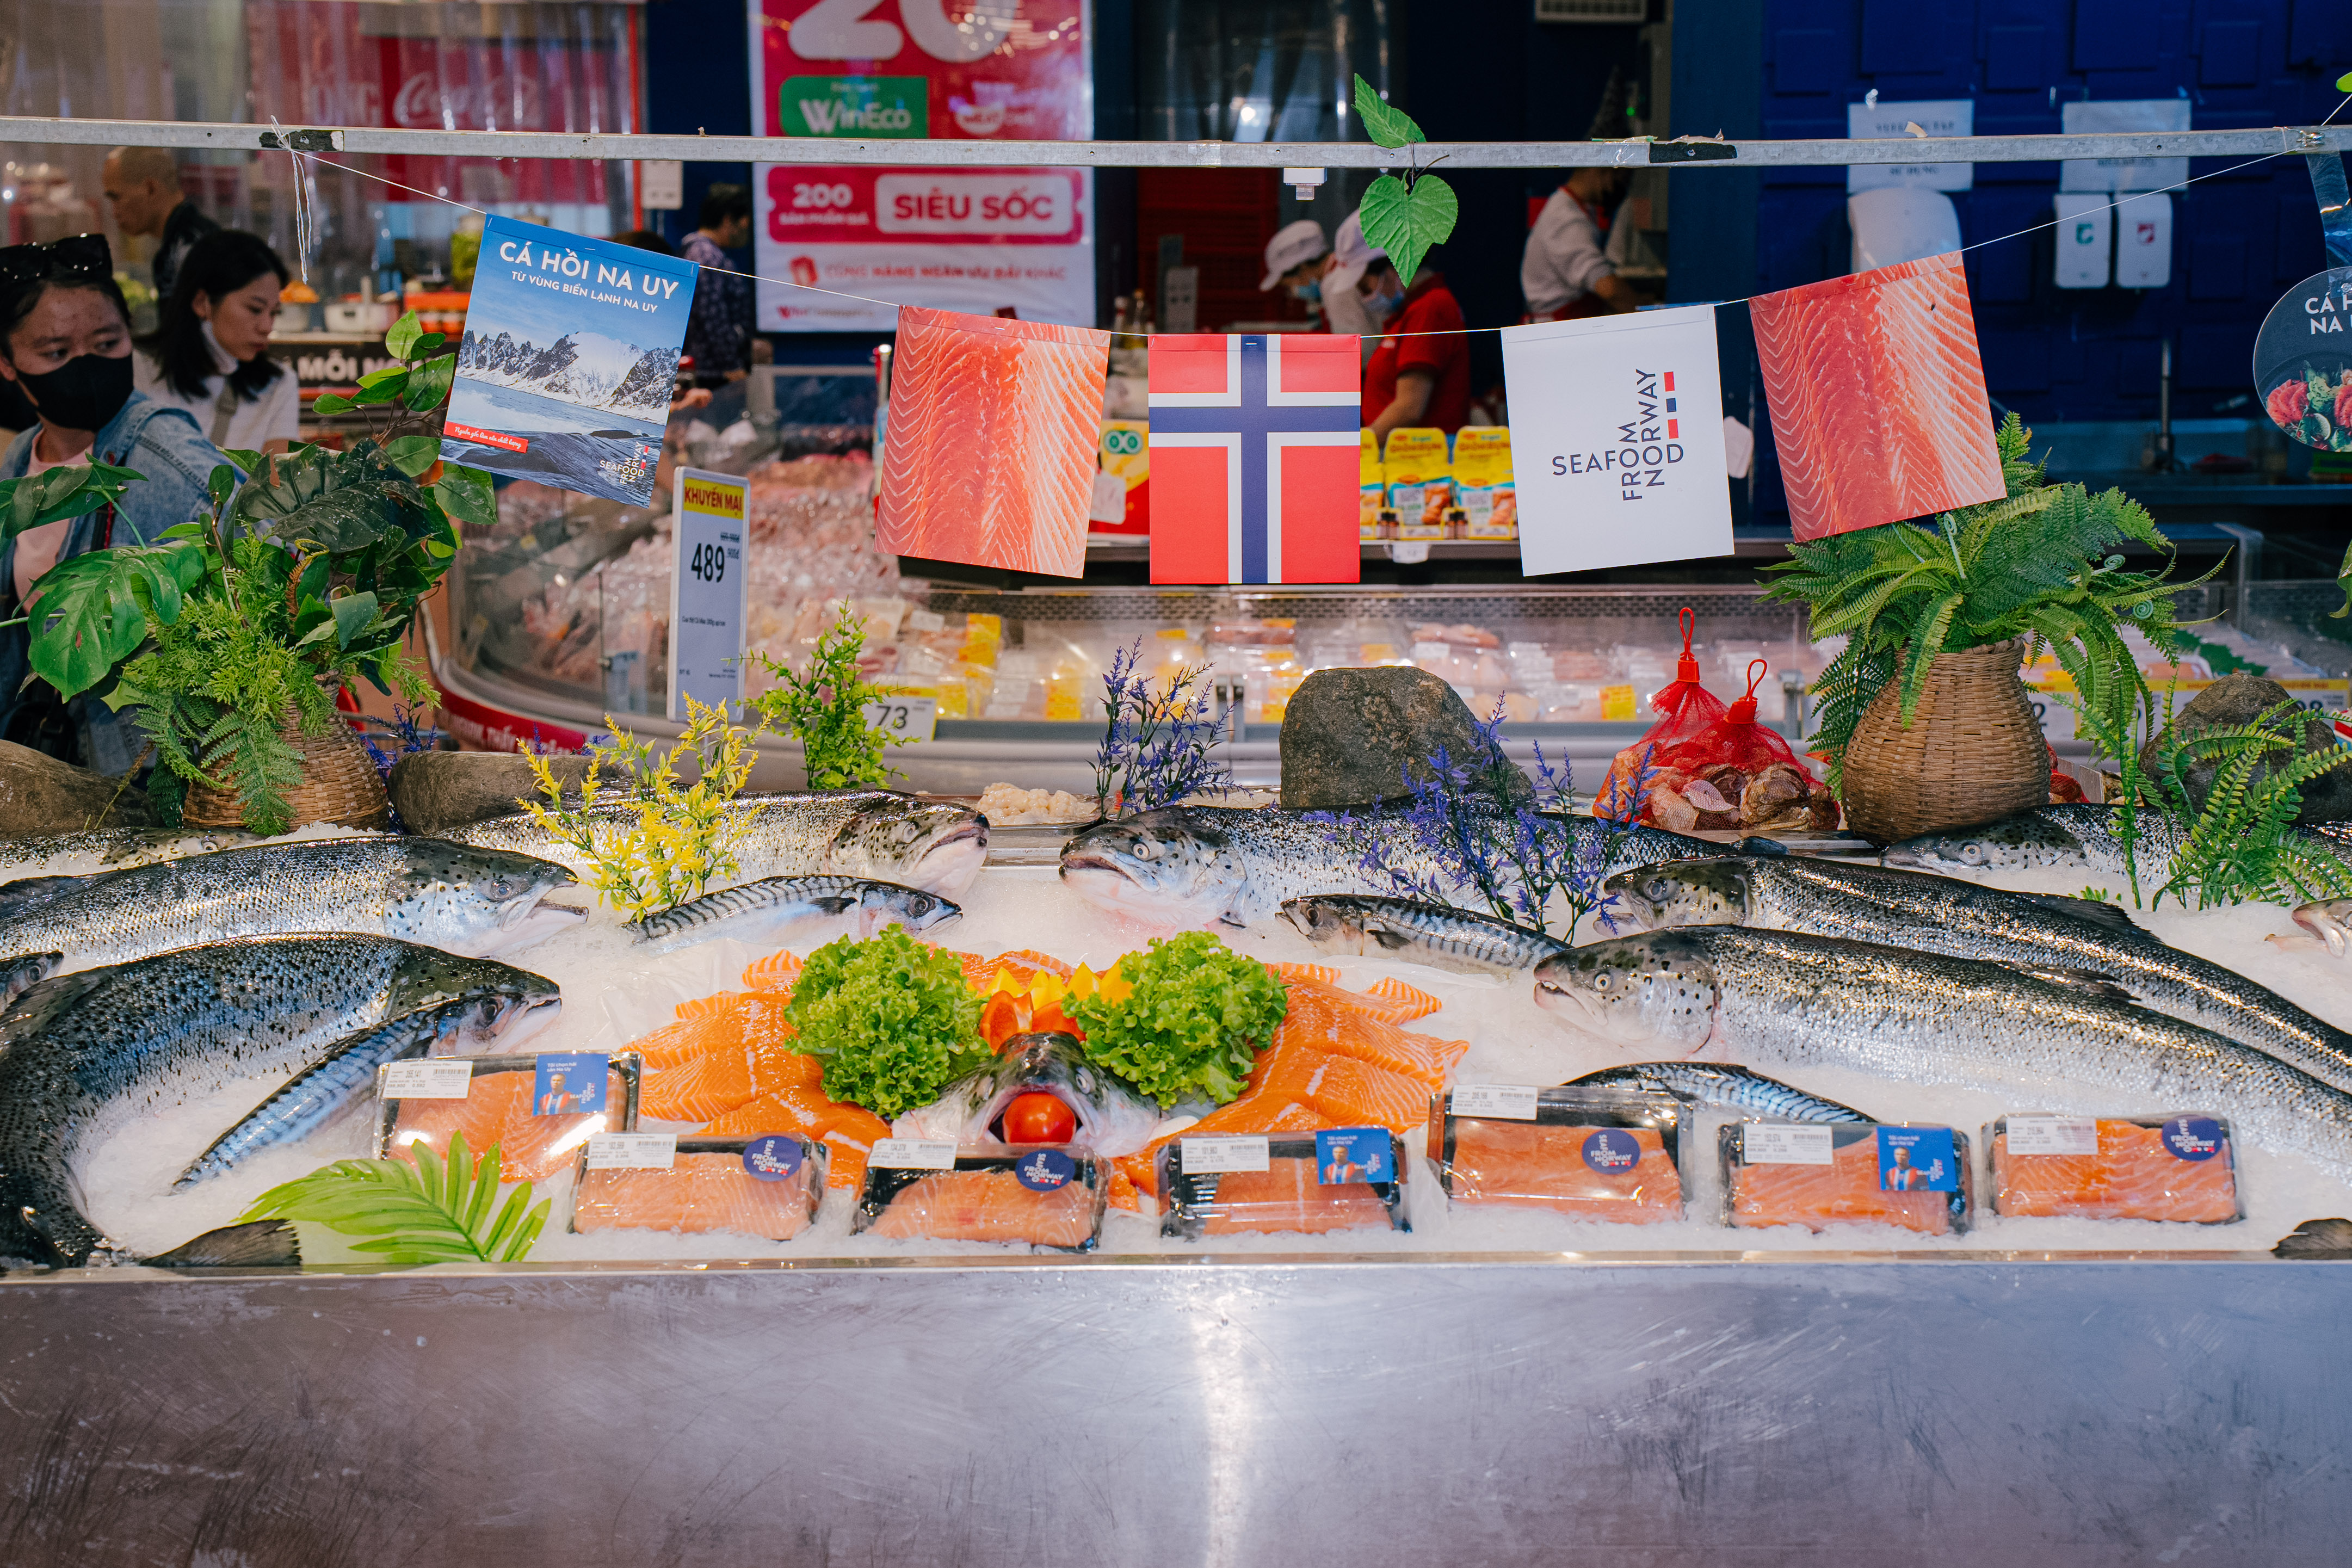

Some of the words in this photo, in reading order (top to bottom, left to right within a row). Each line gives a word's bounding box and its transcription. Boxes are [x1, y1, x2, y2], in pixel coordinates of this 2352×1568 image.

[799, 99, 911, 134] WinEco
[792, 183, 853, 208] 200
[894, 187, 971, 221] SIÊU
[981, 185, 1054, 221] SỐC
[499, 241, 533, 267] CÁ
[541, 248, 590, 280] HỒI
[597, 263, 633, 291] NA
[642, 274, 679, 299] UY
[511, 270, 526, 282] TỪ
[529, 274, 560, 291] VÙNG
[563, 283, 588, 298] BIỂN
[591, 290, 621, 305] LẠNH
[624, 298, 639, 310] NA
[642, 302, 658, 313] UY
[2305, 292, 2335, 314] CÁ
[2310, 316, 2343, 335] NA
[1635, 368, 1665, 487] NORWAY
[600, 460, 645, 477] SEAFOOD
[619, 457, 632, 485] FROM
[628, 441, 645, 483] NORWAY
[1552, 444, 1684, 476] SEAFOOD
[1617, 421, 1643, 501] FROM
[684, 486, 722, 508] KHUYẾN
[691, 543, 725, 583] 489
[753, 1159, 792, 1170] NORWAY
